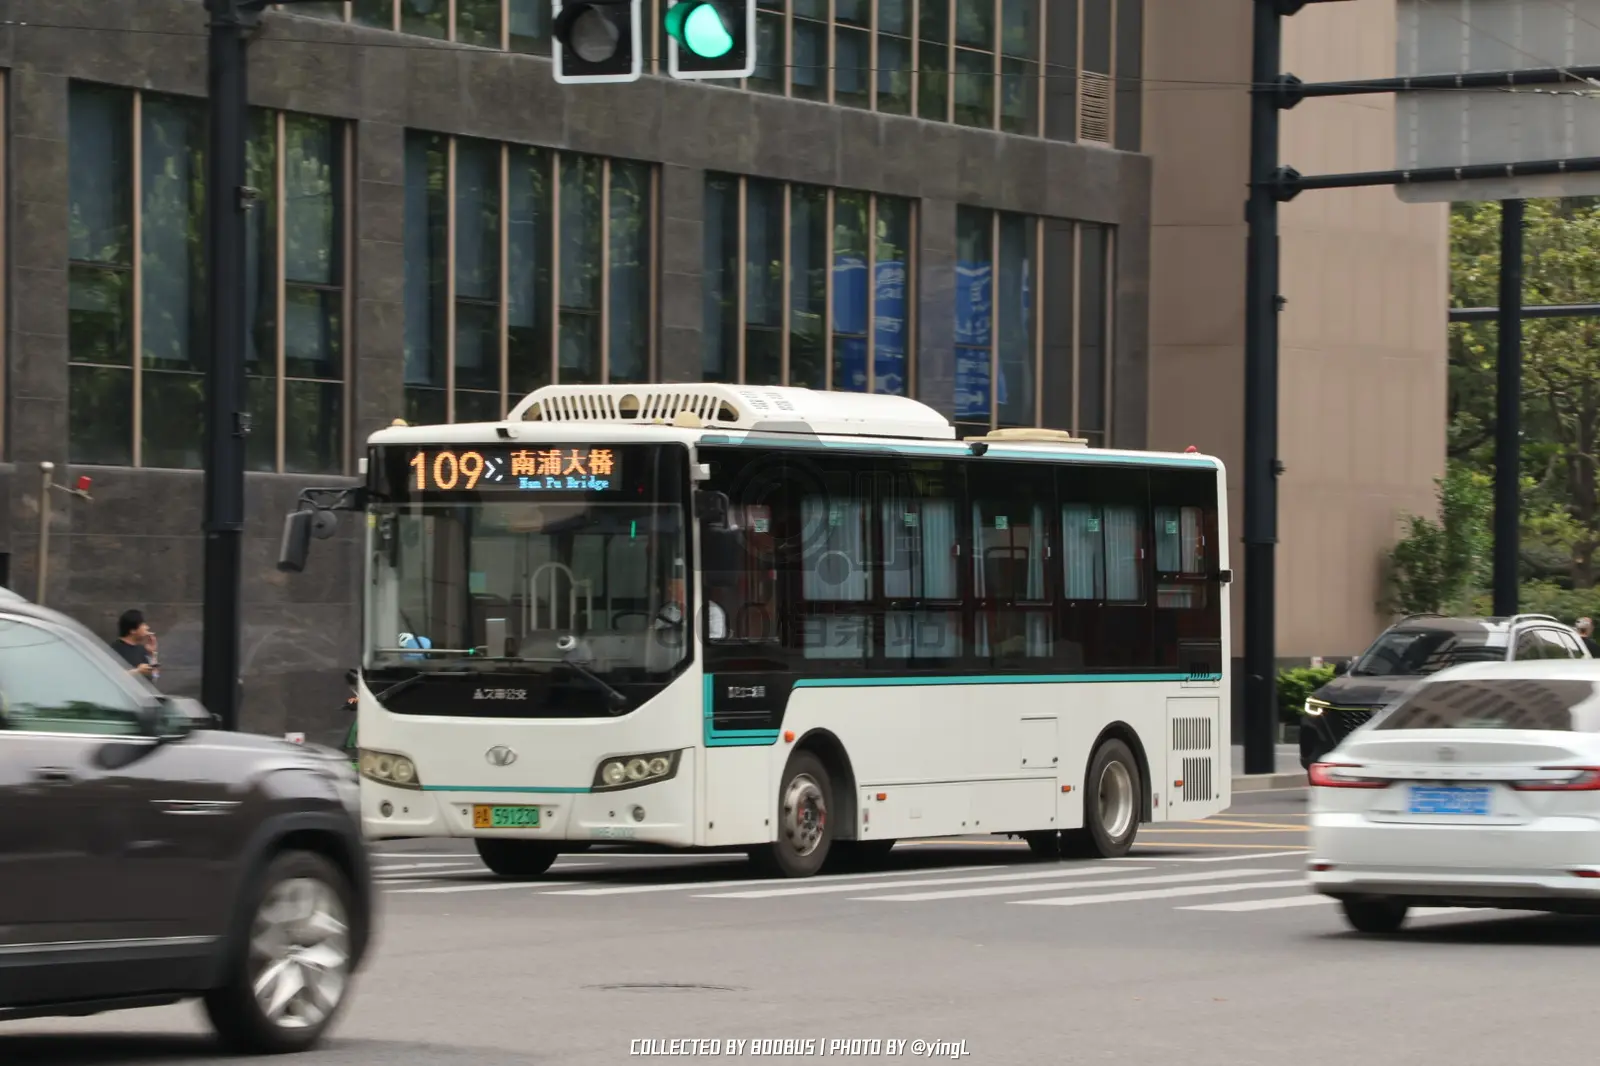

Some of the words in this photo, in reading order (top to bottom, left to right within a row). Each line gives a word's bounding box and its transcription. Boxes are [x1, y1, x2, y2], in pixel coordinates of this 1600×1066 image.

[409, 451, 484, 490] 109
[510, 449, 614, 476] 南浦大桥
[546, 477, 562, 489] Pu
[566, 476, 609, 490] Bridge
